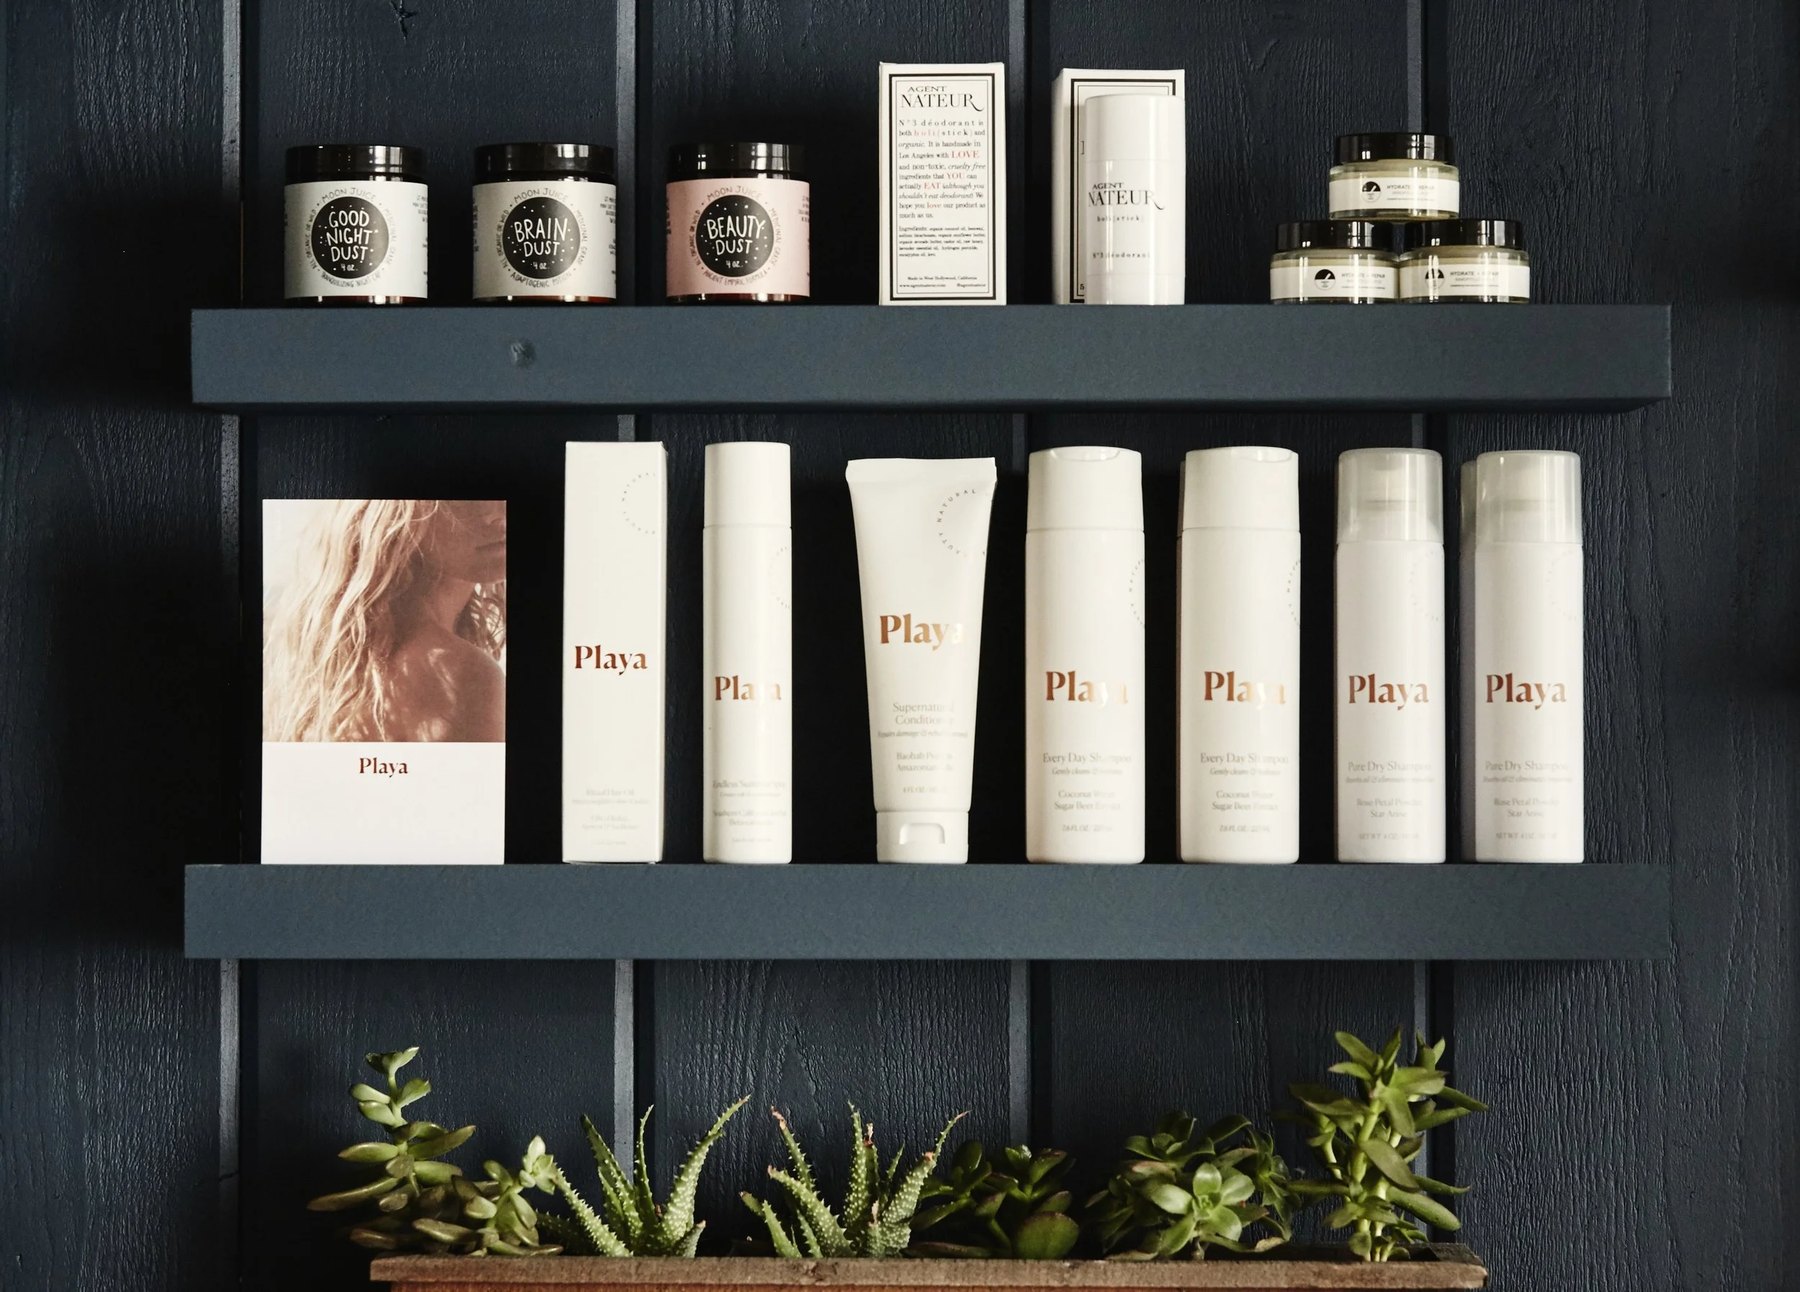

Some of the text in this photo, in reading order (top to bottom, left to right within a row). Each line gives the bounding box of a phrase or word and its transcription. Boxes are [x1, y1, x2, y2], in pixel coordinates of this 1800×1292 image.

[900, 94, 984, 112] NATEUR
[951, 150, 980, 158] LOVE
[972, 163, 986, 172] free
[707, 186, 761, 201] MOON JUICE
[899, 182, 921, 190] actually
[1092, 182, 1124, 190] AGENT
[322, 187, 376, 203] MOON JUICE
[514, 188, 568, 204] MOON JUICE
[955, 202, 978, 210] product
[328, 210, 370, 228] GOOD
[514, 218, 568, 242] BRAIN
[706, 215, 765, 240] BEAUTY
[326, 228, 373, 246] NIGHT
[330, 246, 368, 262] DUST
[523, 241, 560, 257] DUST
[715, 239, 753, 256] DUST
[574, 644, 648, 676] Playa
[1348, 673, 1430, 711] Playa
[1486, 672, 1568, 711] Playa
[892, 702, 954, 714] Supernatul
[895, 714, 954, 725] Conditior
[1043, 752, 1131, 765] Every Day Shmpoo
[1200, 752, 1288, 765] Every Day Shmpoo
[1485, 760, 1503, 771] Pure
[1504, 760, 1522, 772] Dry
[360, 757, 408, 778] Playa
[1367, 761, 1384, 773] Dry
